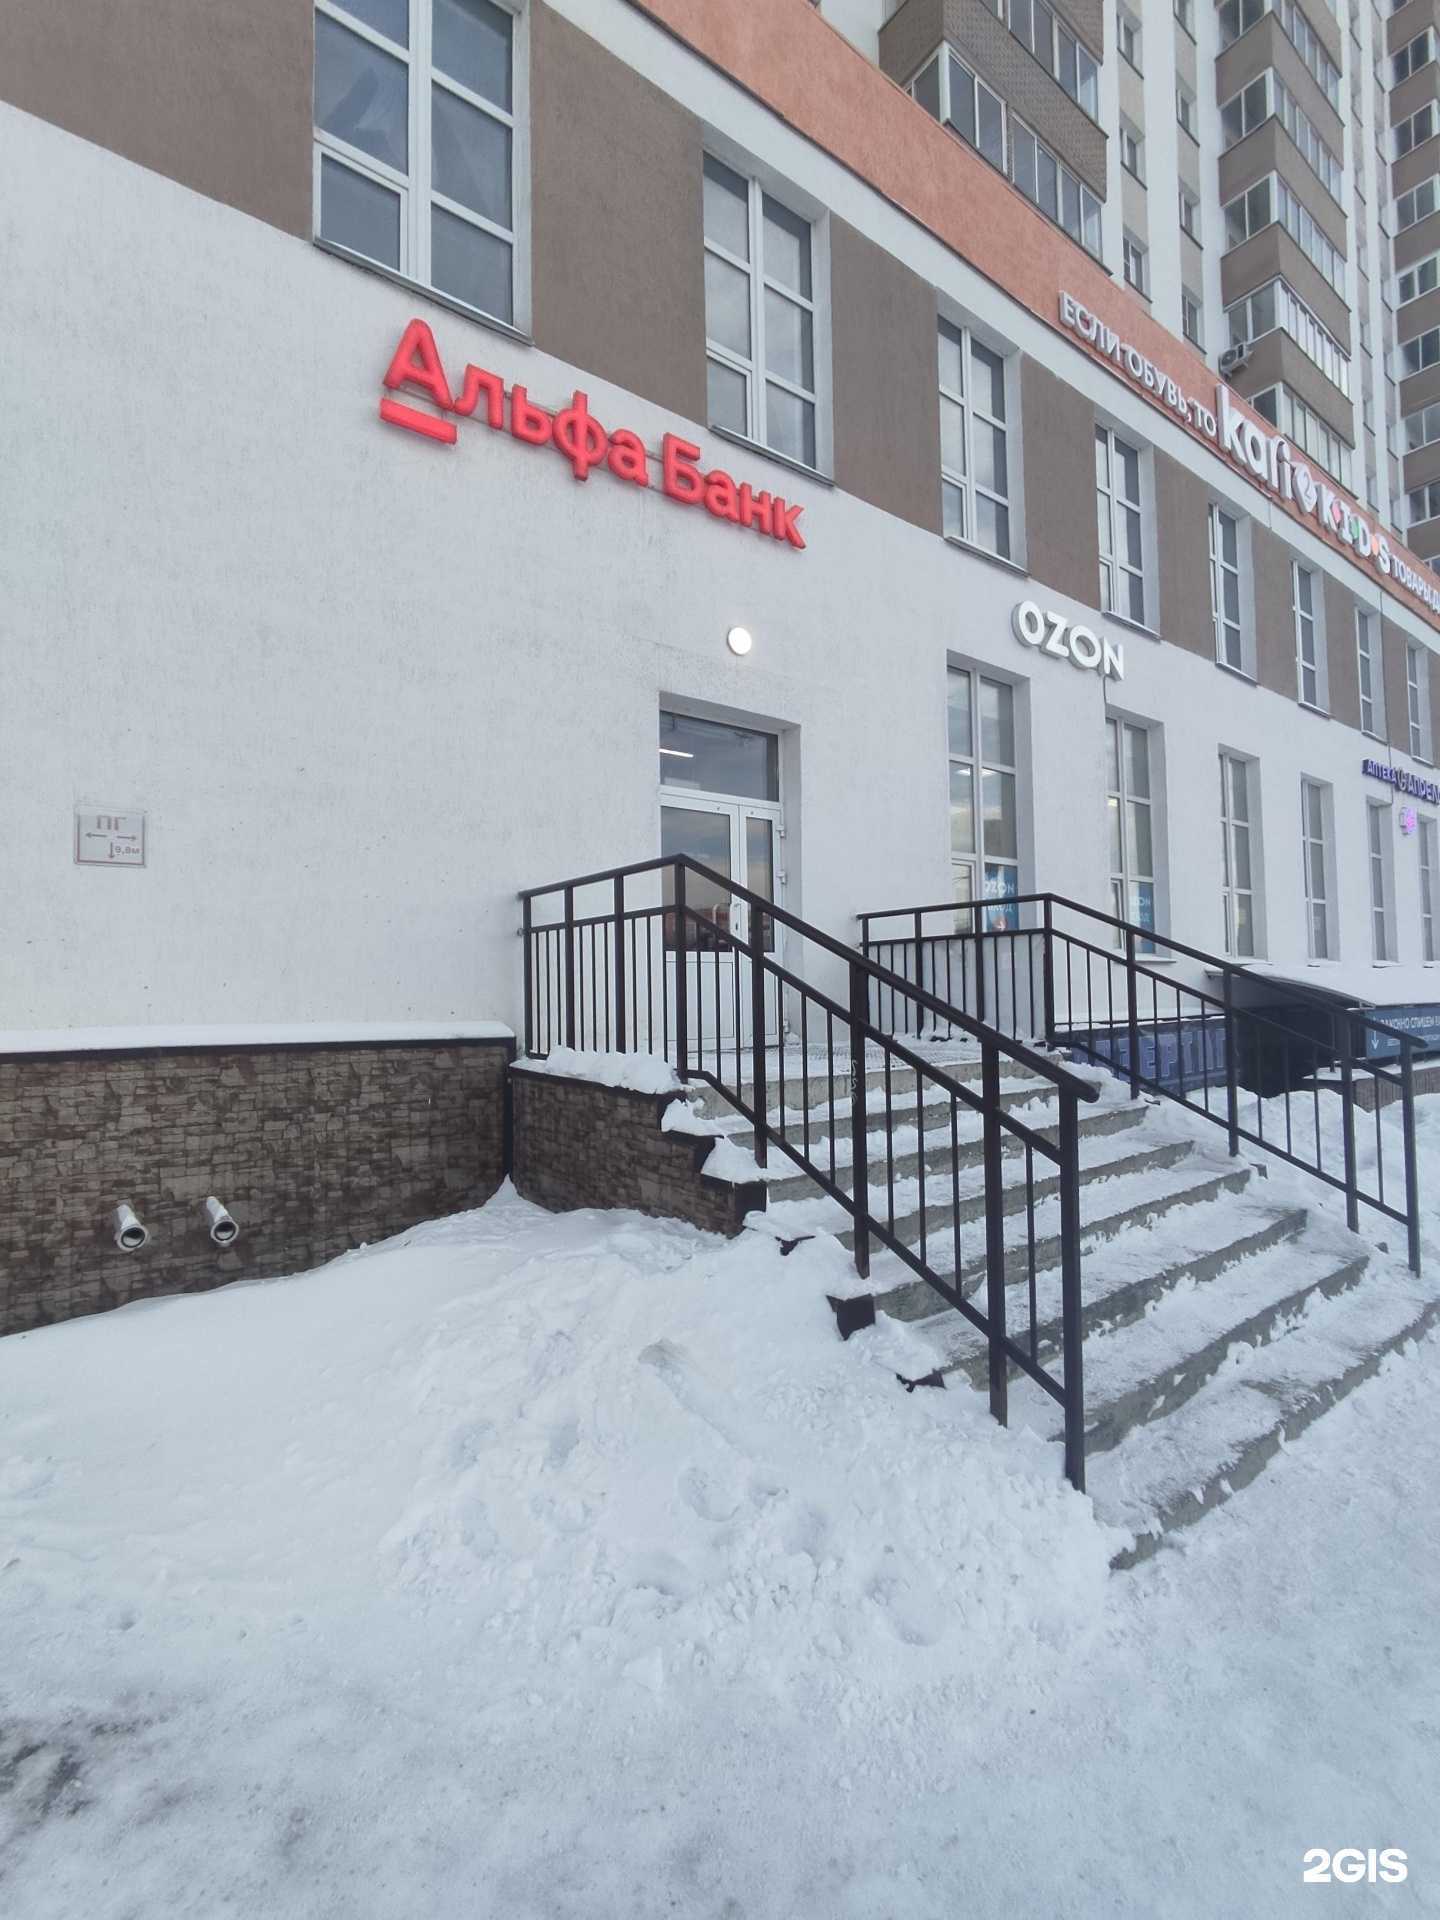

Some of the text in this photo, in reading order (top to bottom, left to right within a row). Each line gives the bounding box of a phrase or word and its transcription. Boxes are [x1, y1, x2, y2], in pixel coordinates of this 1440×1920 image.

[1059, 290, 1121, 363] ЕСЛИ
[1189, 398, 1217, 437] ТО
[380, 318, 807, 549] Альфа Банк
[1012, 600, 1124, 681] OZON
[1364, 759, 1397, 784] АПТЕКА
[96, 815, 128, 831] ПГ
